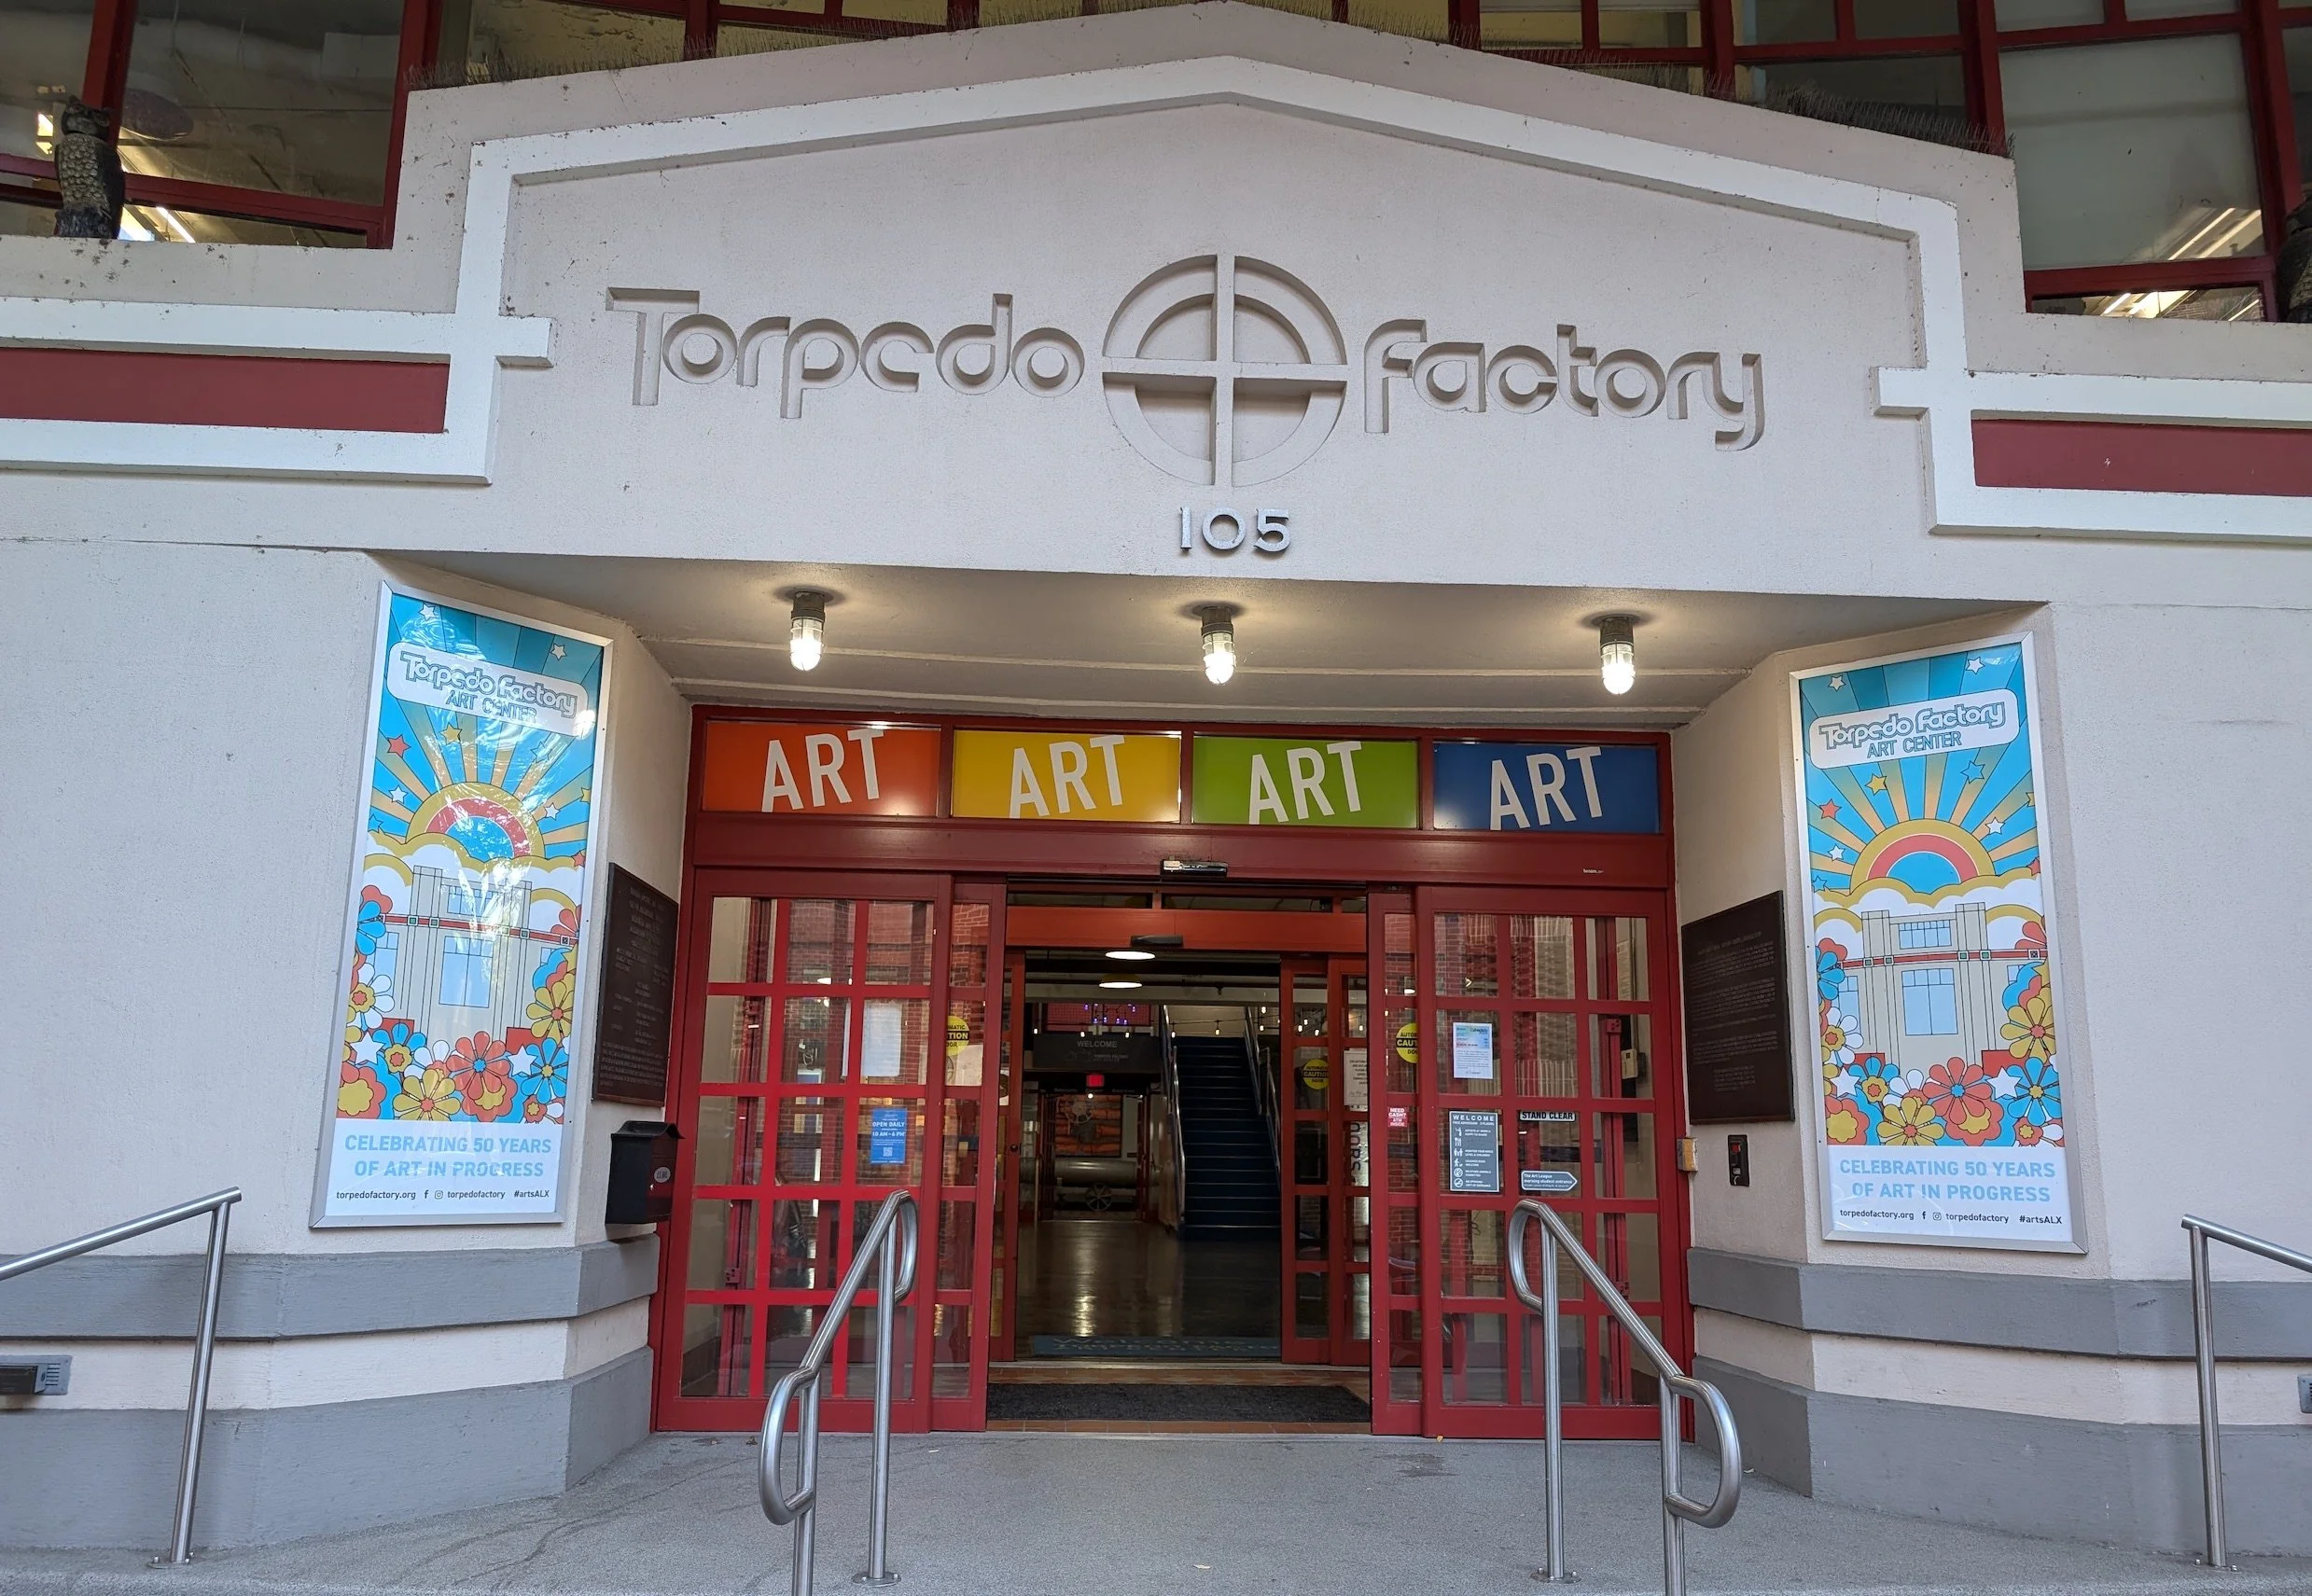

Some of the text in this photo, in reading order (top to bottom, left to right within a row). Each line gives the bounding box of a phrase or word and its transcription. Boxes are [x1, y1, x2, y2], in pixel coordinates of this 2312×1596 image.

[606, 287, 1085, 419] Torpedo
[1178, 507, 1292, 553] 105
[400, 651, 495, 695] Torpedo
[446, 690, 536, 722] ART CENTER
[1819, 714, 1914, 750] Torpedo
[1867, 731, 1962, 758] ART CENTER
[761, 729, 884, 813] ART
[1009, 734, 1126, 820] ART
[1249, 741, 1362, 825] ART
[1489, 746, 1601, 831] ART
[345, 1134, 551, 1153] CELEBRATING 50 YEARS
[355, 1160, 544, 1177] OF ART IN PROGRESS
[1840, 1159, 2056, 1178] CELEBRATING 50 YEARS
[336, 1190, 416, 1200] torpedofactory.org
[447, 1189, 506, 1200] torpedofactory
[514, 1189, 550, 1199] #artsALX
[1852, 1182, 2051, 1202] OF ART IN PROGRESS
[1840, 1209, 1915, 1221] torpedofactory.org
[1945, 1213, 2009, 1224] torpedofactory
[2019, 1214, 2062, 1225] #artsALX
